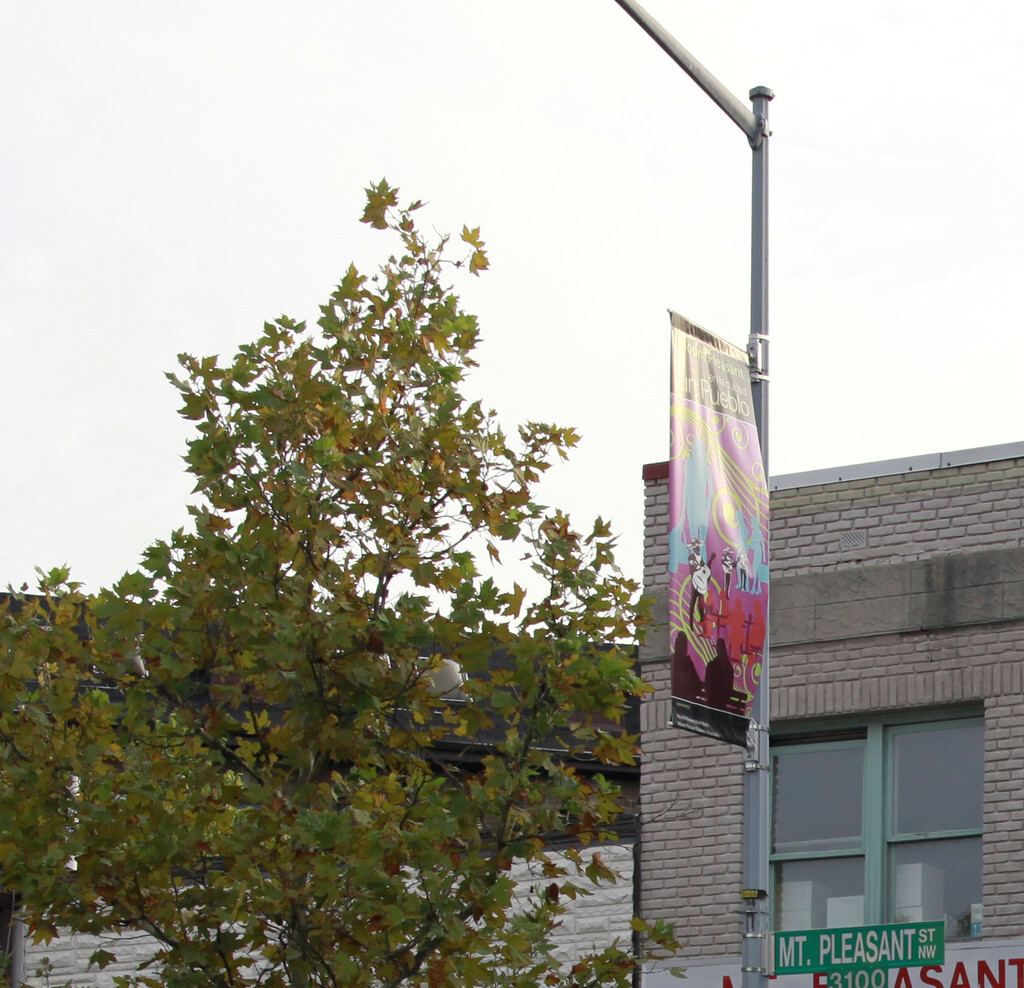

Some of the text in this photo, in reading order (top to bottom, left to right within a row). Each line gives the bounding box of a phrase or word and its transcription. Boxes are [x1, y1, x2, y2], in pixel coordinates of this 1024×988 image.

[701, 377, 750, 417] Pueblo
[779, 928, 936, 968] MT. PLEASANT ST
[918, 944, 937, 959] NW
